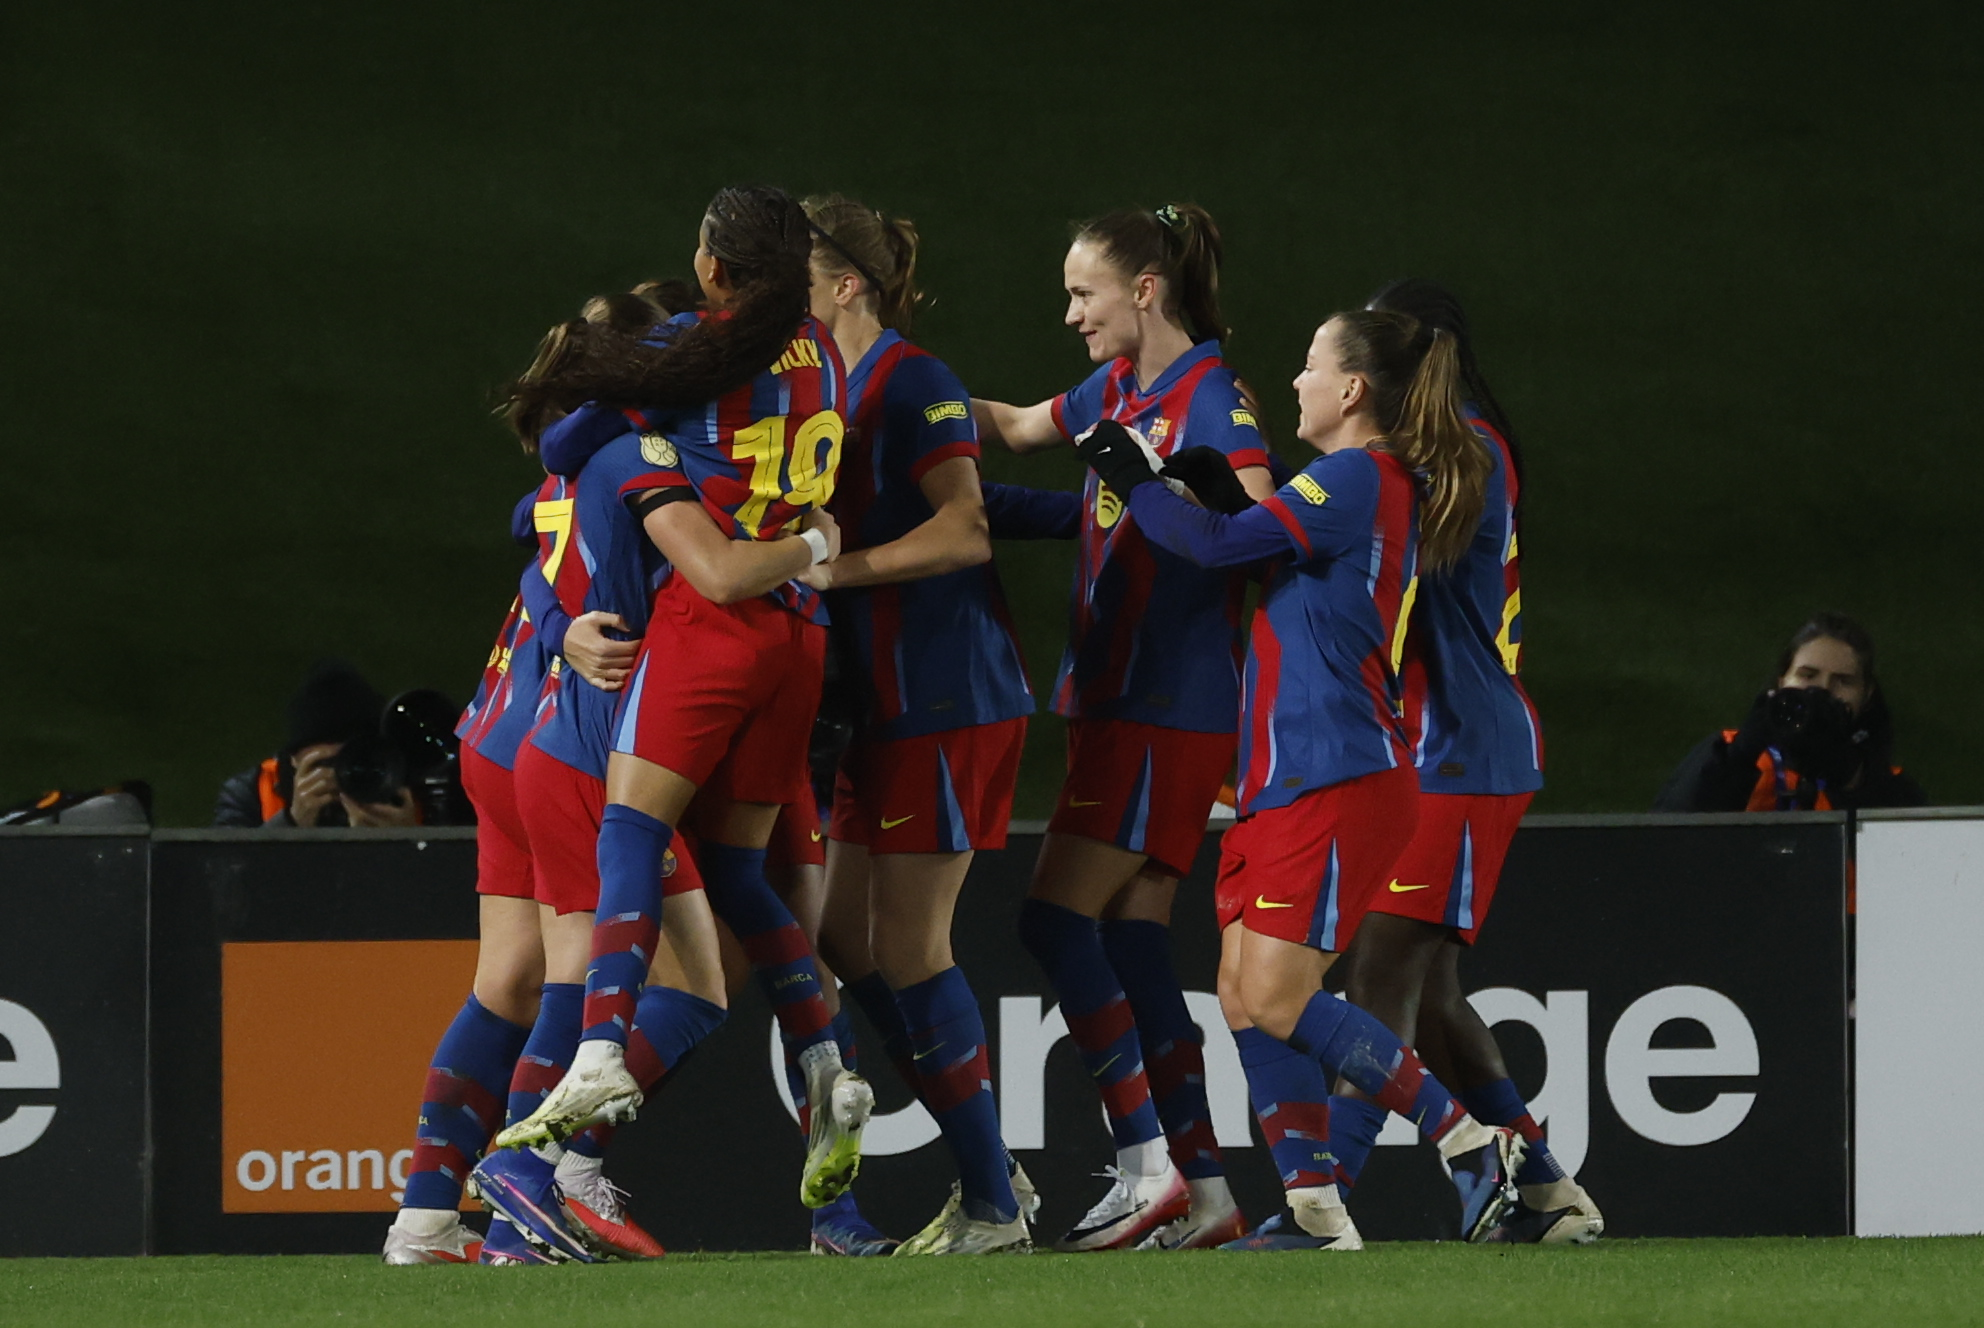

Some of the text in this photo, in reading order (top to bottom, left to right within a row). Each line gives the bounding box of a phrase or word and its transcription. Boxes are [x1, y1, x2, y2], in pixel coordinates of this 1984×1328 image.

[924, 403, 967, 422] BIMBO
[770, 984, 1760, 1184] orge
[236, 1149, 414, 1204] orang
